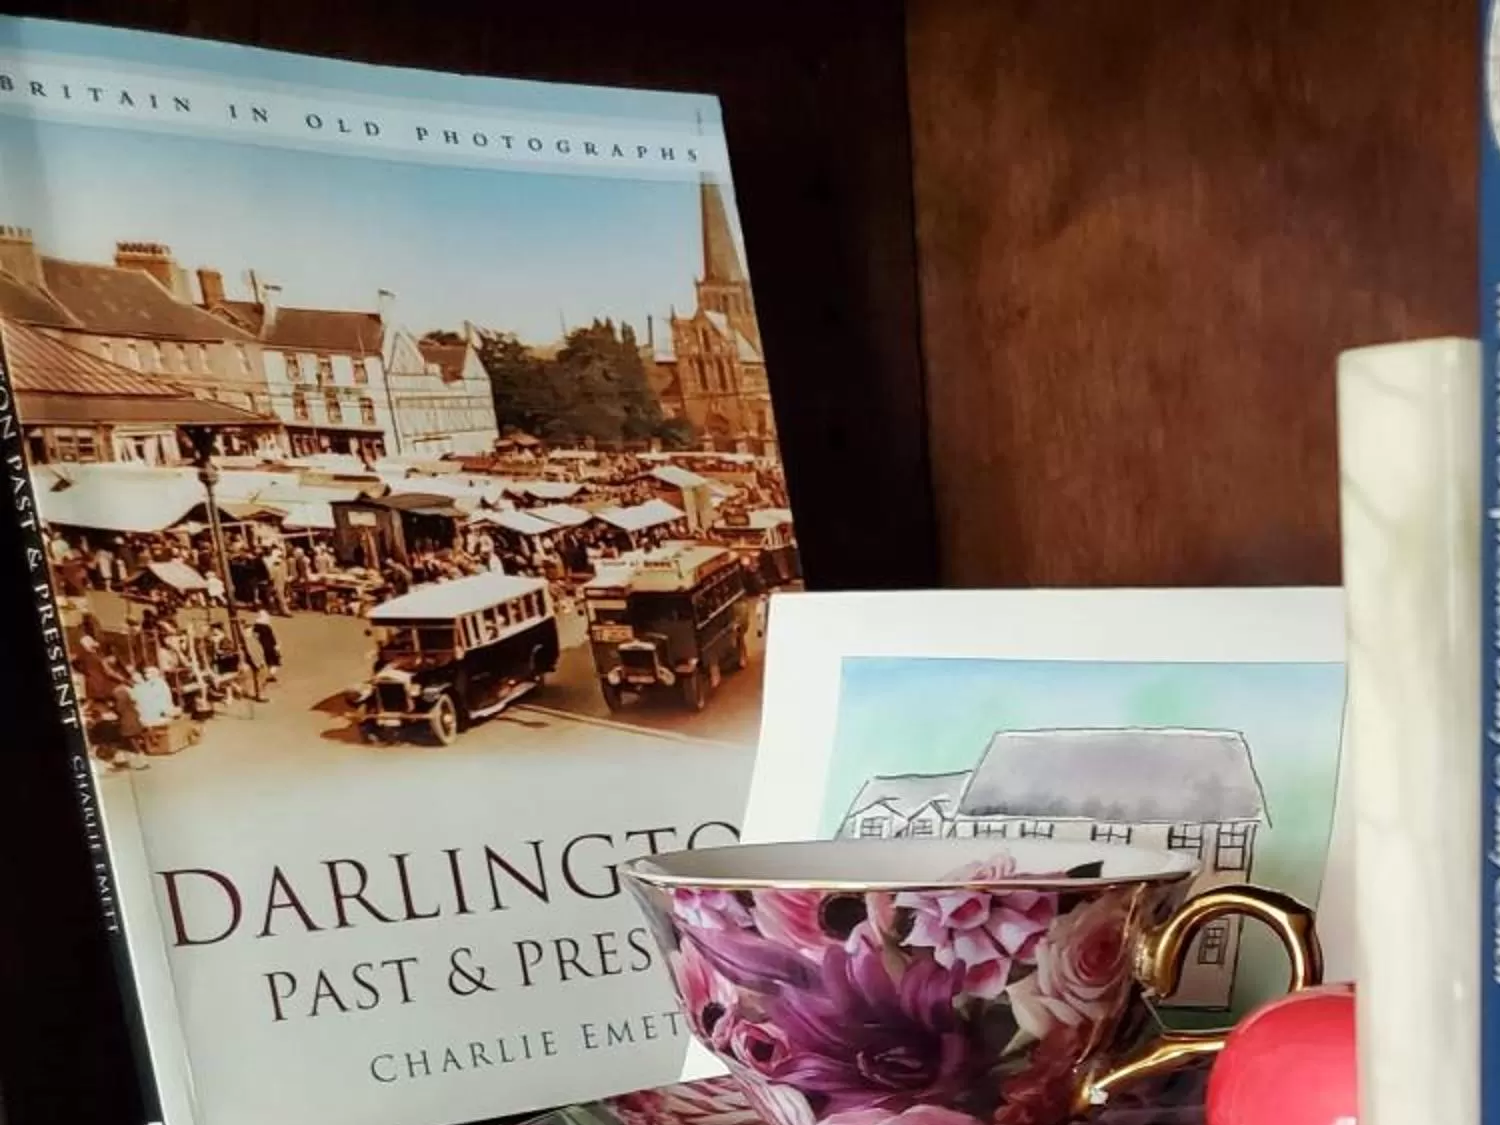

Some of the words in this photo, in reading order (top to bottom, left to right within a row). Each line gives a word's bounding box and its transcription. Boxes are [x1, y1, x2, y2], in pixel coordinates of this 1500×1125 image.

[0, 75, 191, 112] BRITAIN
[229, 104, 268, 123] IN
[305, 113, 380, 137] OLD
[416, 126, 698, 162] PHOTOGRAPHS
[7, 455, 37, 532] PAST
[26, 547, 42, 571] &
[33, 583, 79, 729] PRESENT
[264, 958, 417, 1023] PAST
[447, 948, 497, 997] &
[370, 1031, 557, 1084] CHARLIE
